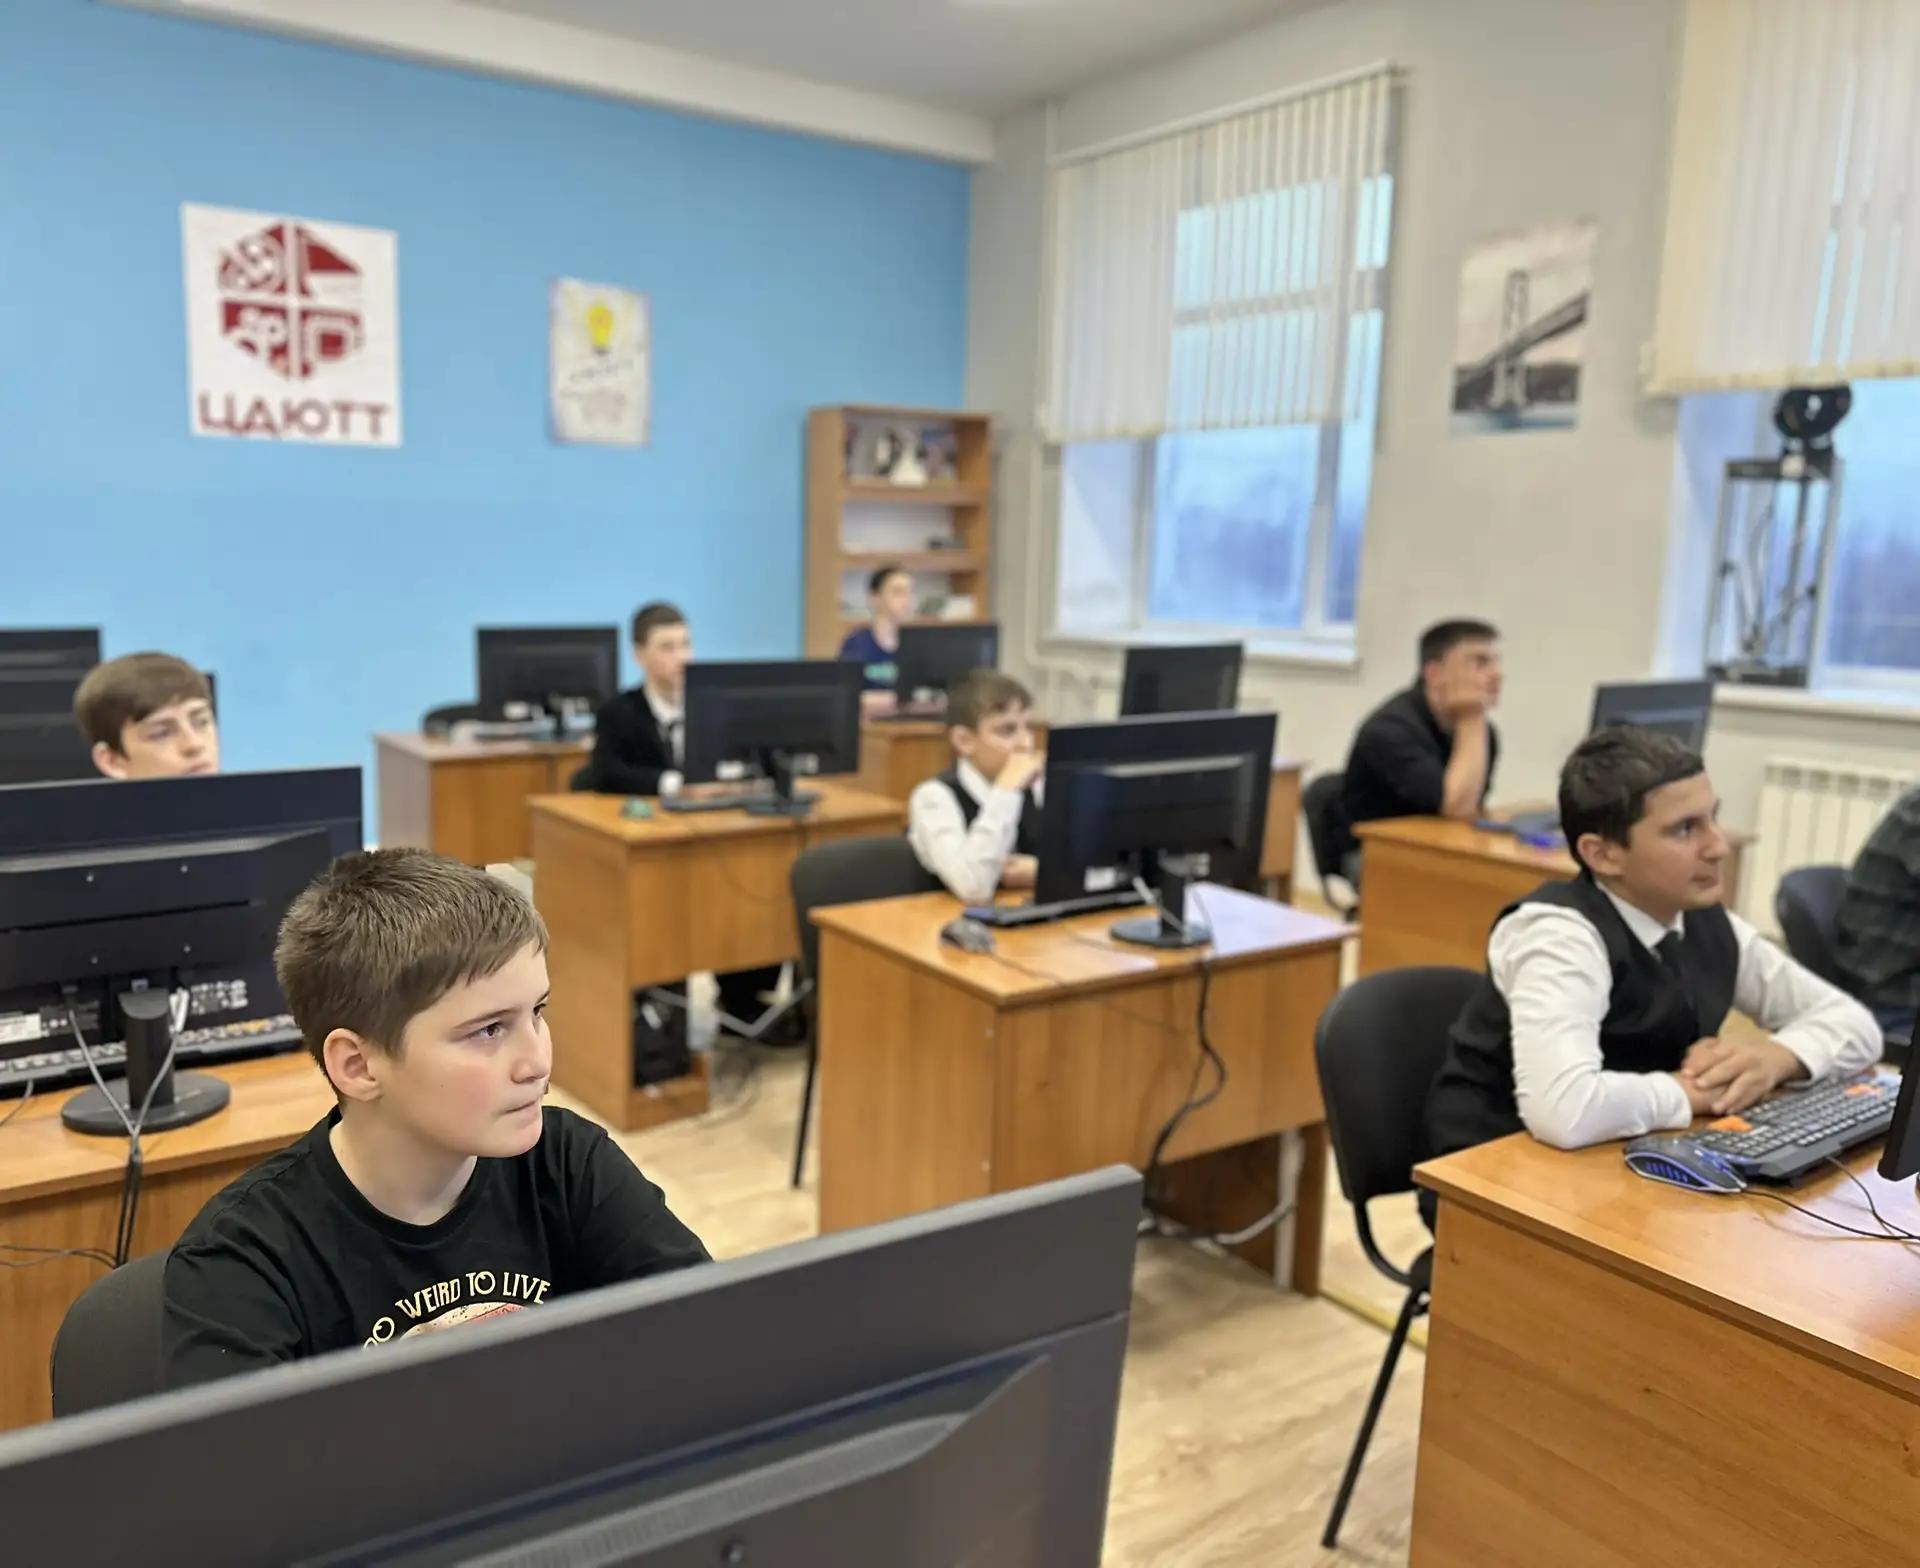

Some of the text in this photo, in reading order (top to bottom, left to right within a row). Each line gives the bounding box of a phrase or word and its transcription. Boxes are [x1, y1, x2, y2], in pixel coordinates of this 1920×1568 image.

[395, 1278, 461, 1319] WEIRD
[465, 1270, 497, 1297] TO
[503, 1271, 551, 1304] LIVE
